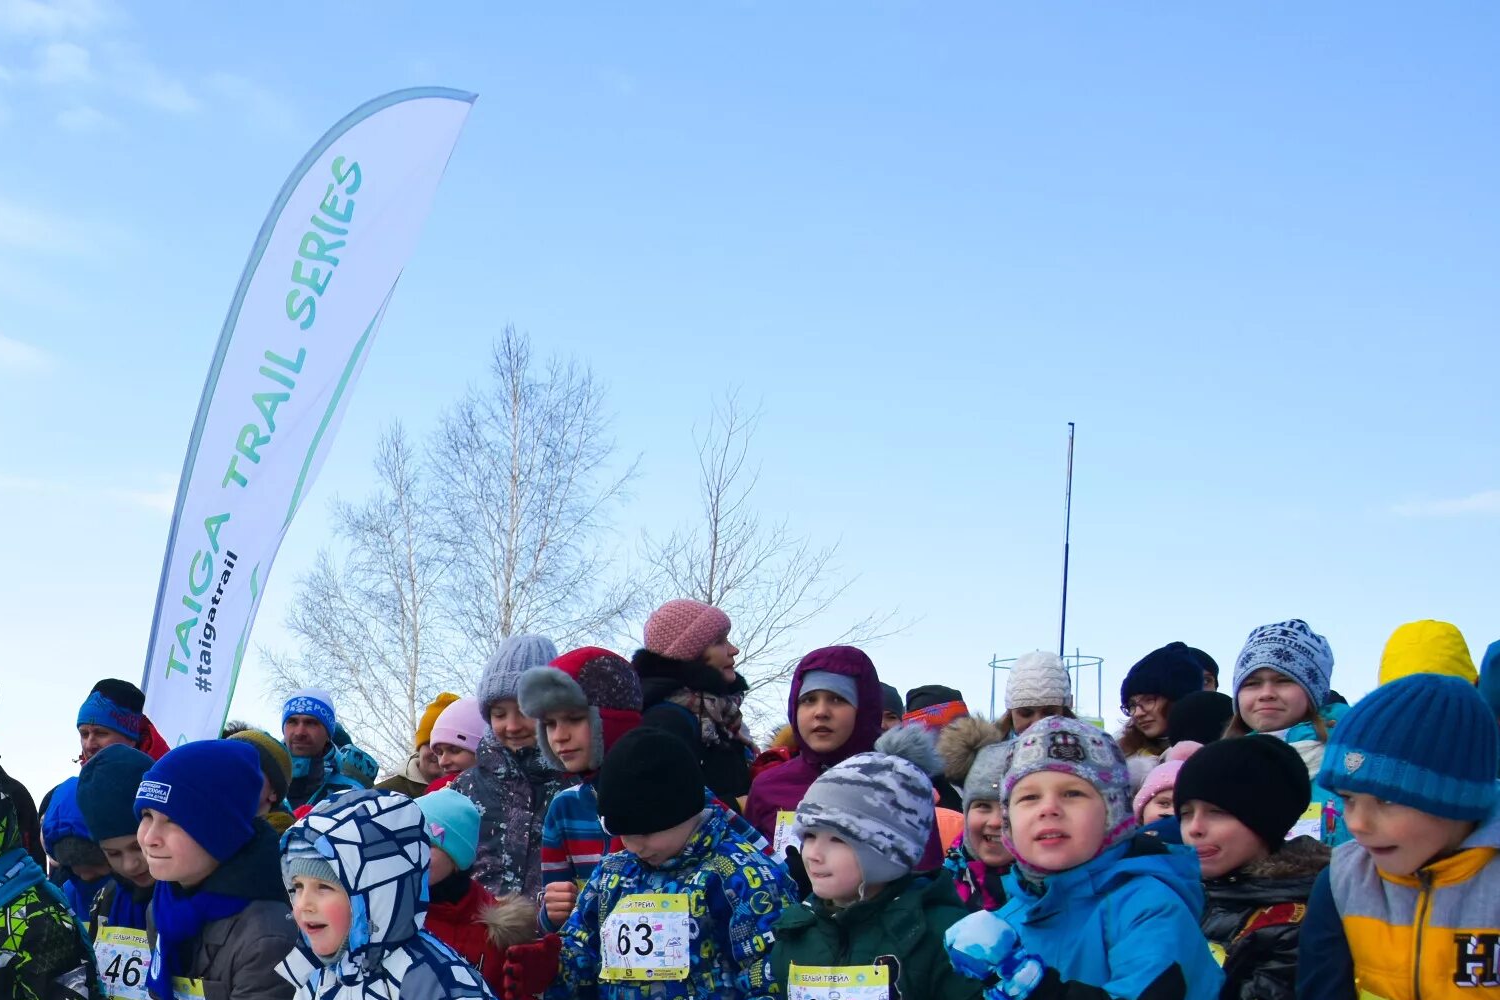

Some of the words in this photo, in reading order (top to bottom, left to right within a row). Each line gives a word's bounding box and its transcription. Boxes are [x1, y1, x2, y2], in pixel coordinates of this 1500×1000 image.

[165, 513, 230, 680] TAIGA
[221, 347, 307, 489] TRAIL
[285, 155, 362, 331] SERIES
[194, 550, 239, 693] #taigatrail
[1252, 636, 1315, 659] MARATHON
[634, 900, 656, 909] ТРЕЙЛ
[617, 923, 654, 957] 63
[104, 954, 143, 987] 46
[824, 974, 850, 983] ТРЕЙЛ
